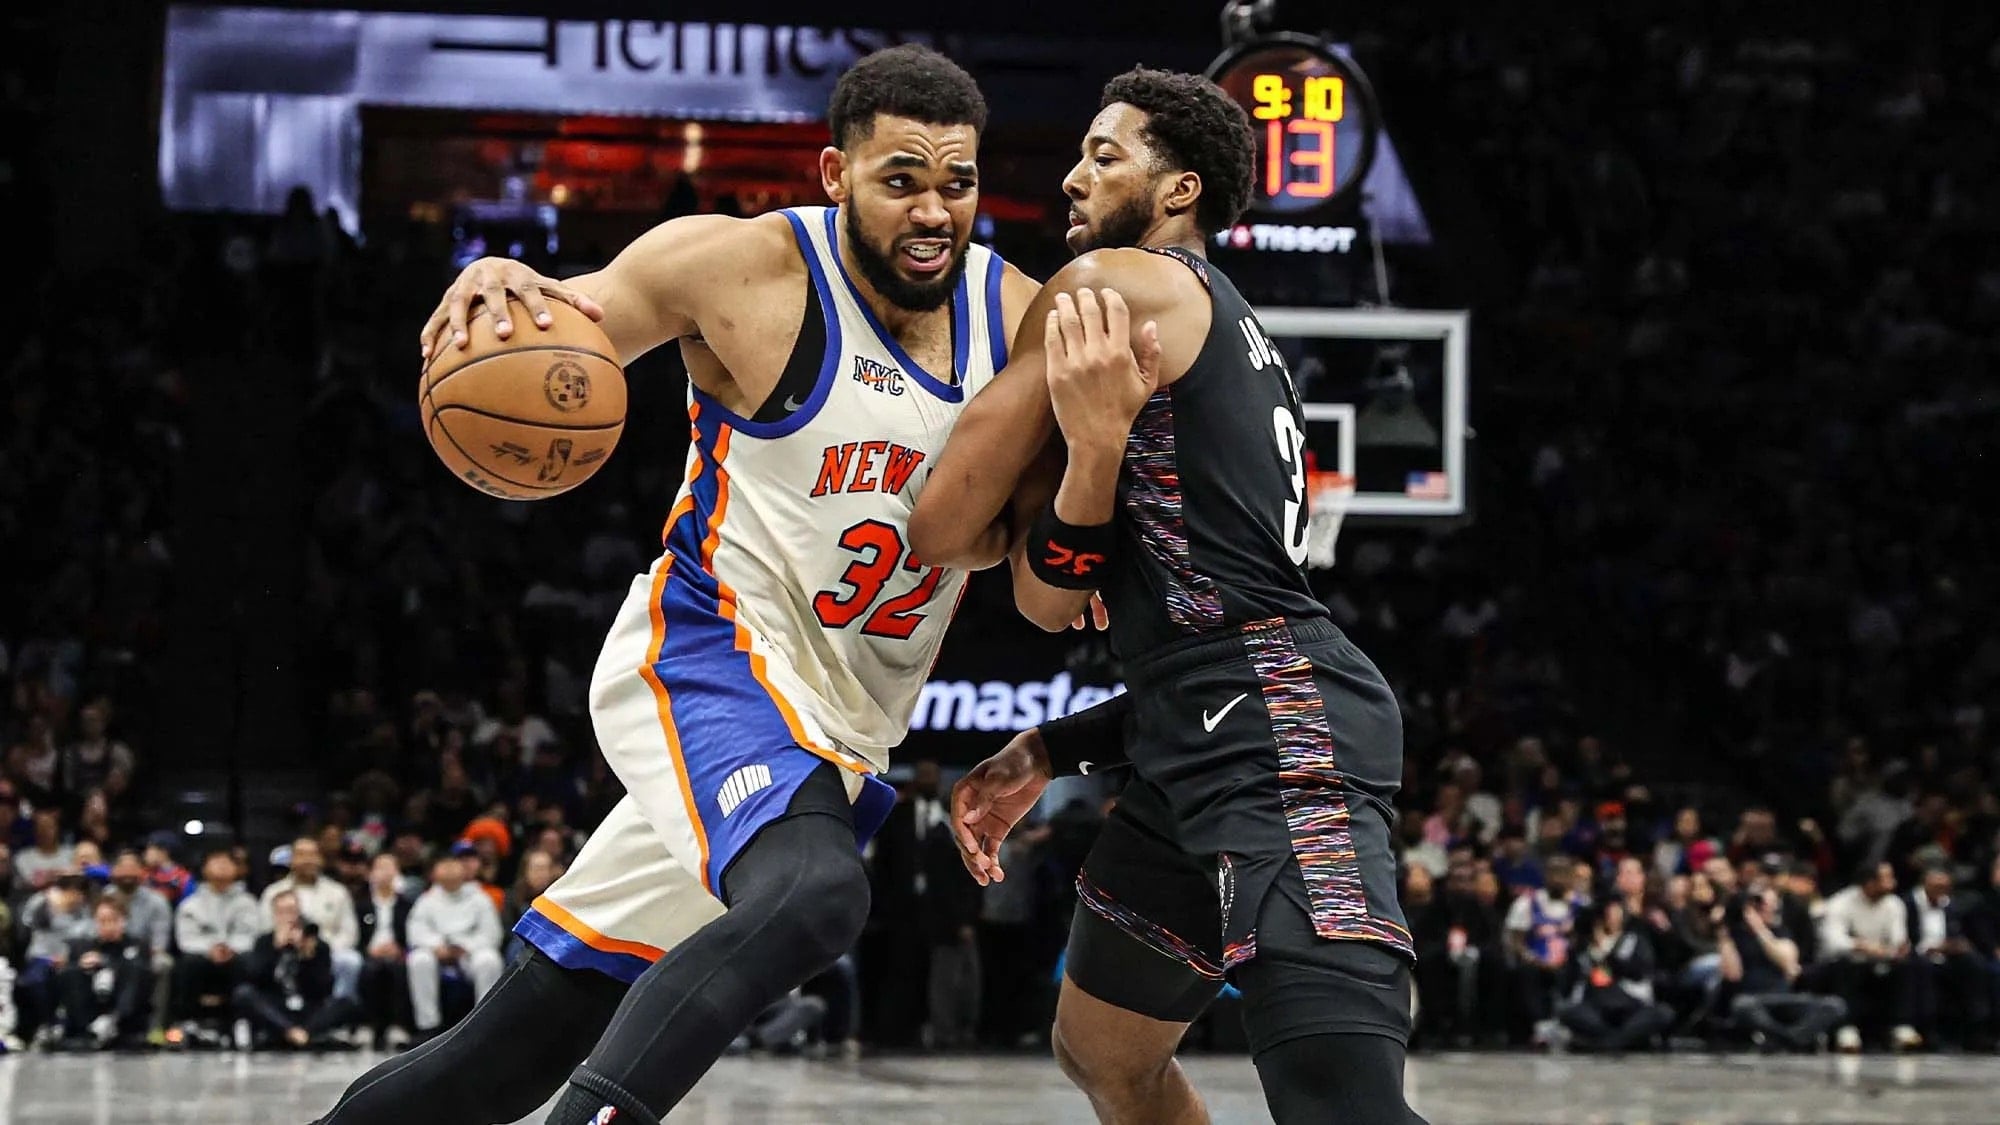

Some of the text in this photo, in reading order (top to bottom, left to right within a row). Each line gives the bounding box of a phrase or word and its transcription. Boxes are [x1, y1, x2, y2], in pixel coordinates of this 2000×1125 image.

[1252, 74, 1344, 122] 9:10
[1265, 119, 1336, 198] 13
[1250, 223, 1357, 253] TISSOT
[853, 356, 904, 396] NYC
[810, 440, 925, 498] NEW
[812, 518, 945, 640] 32
